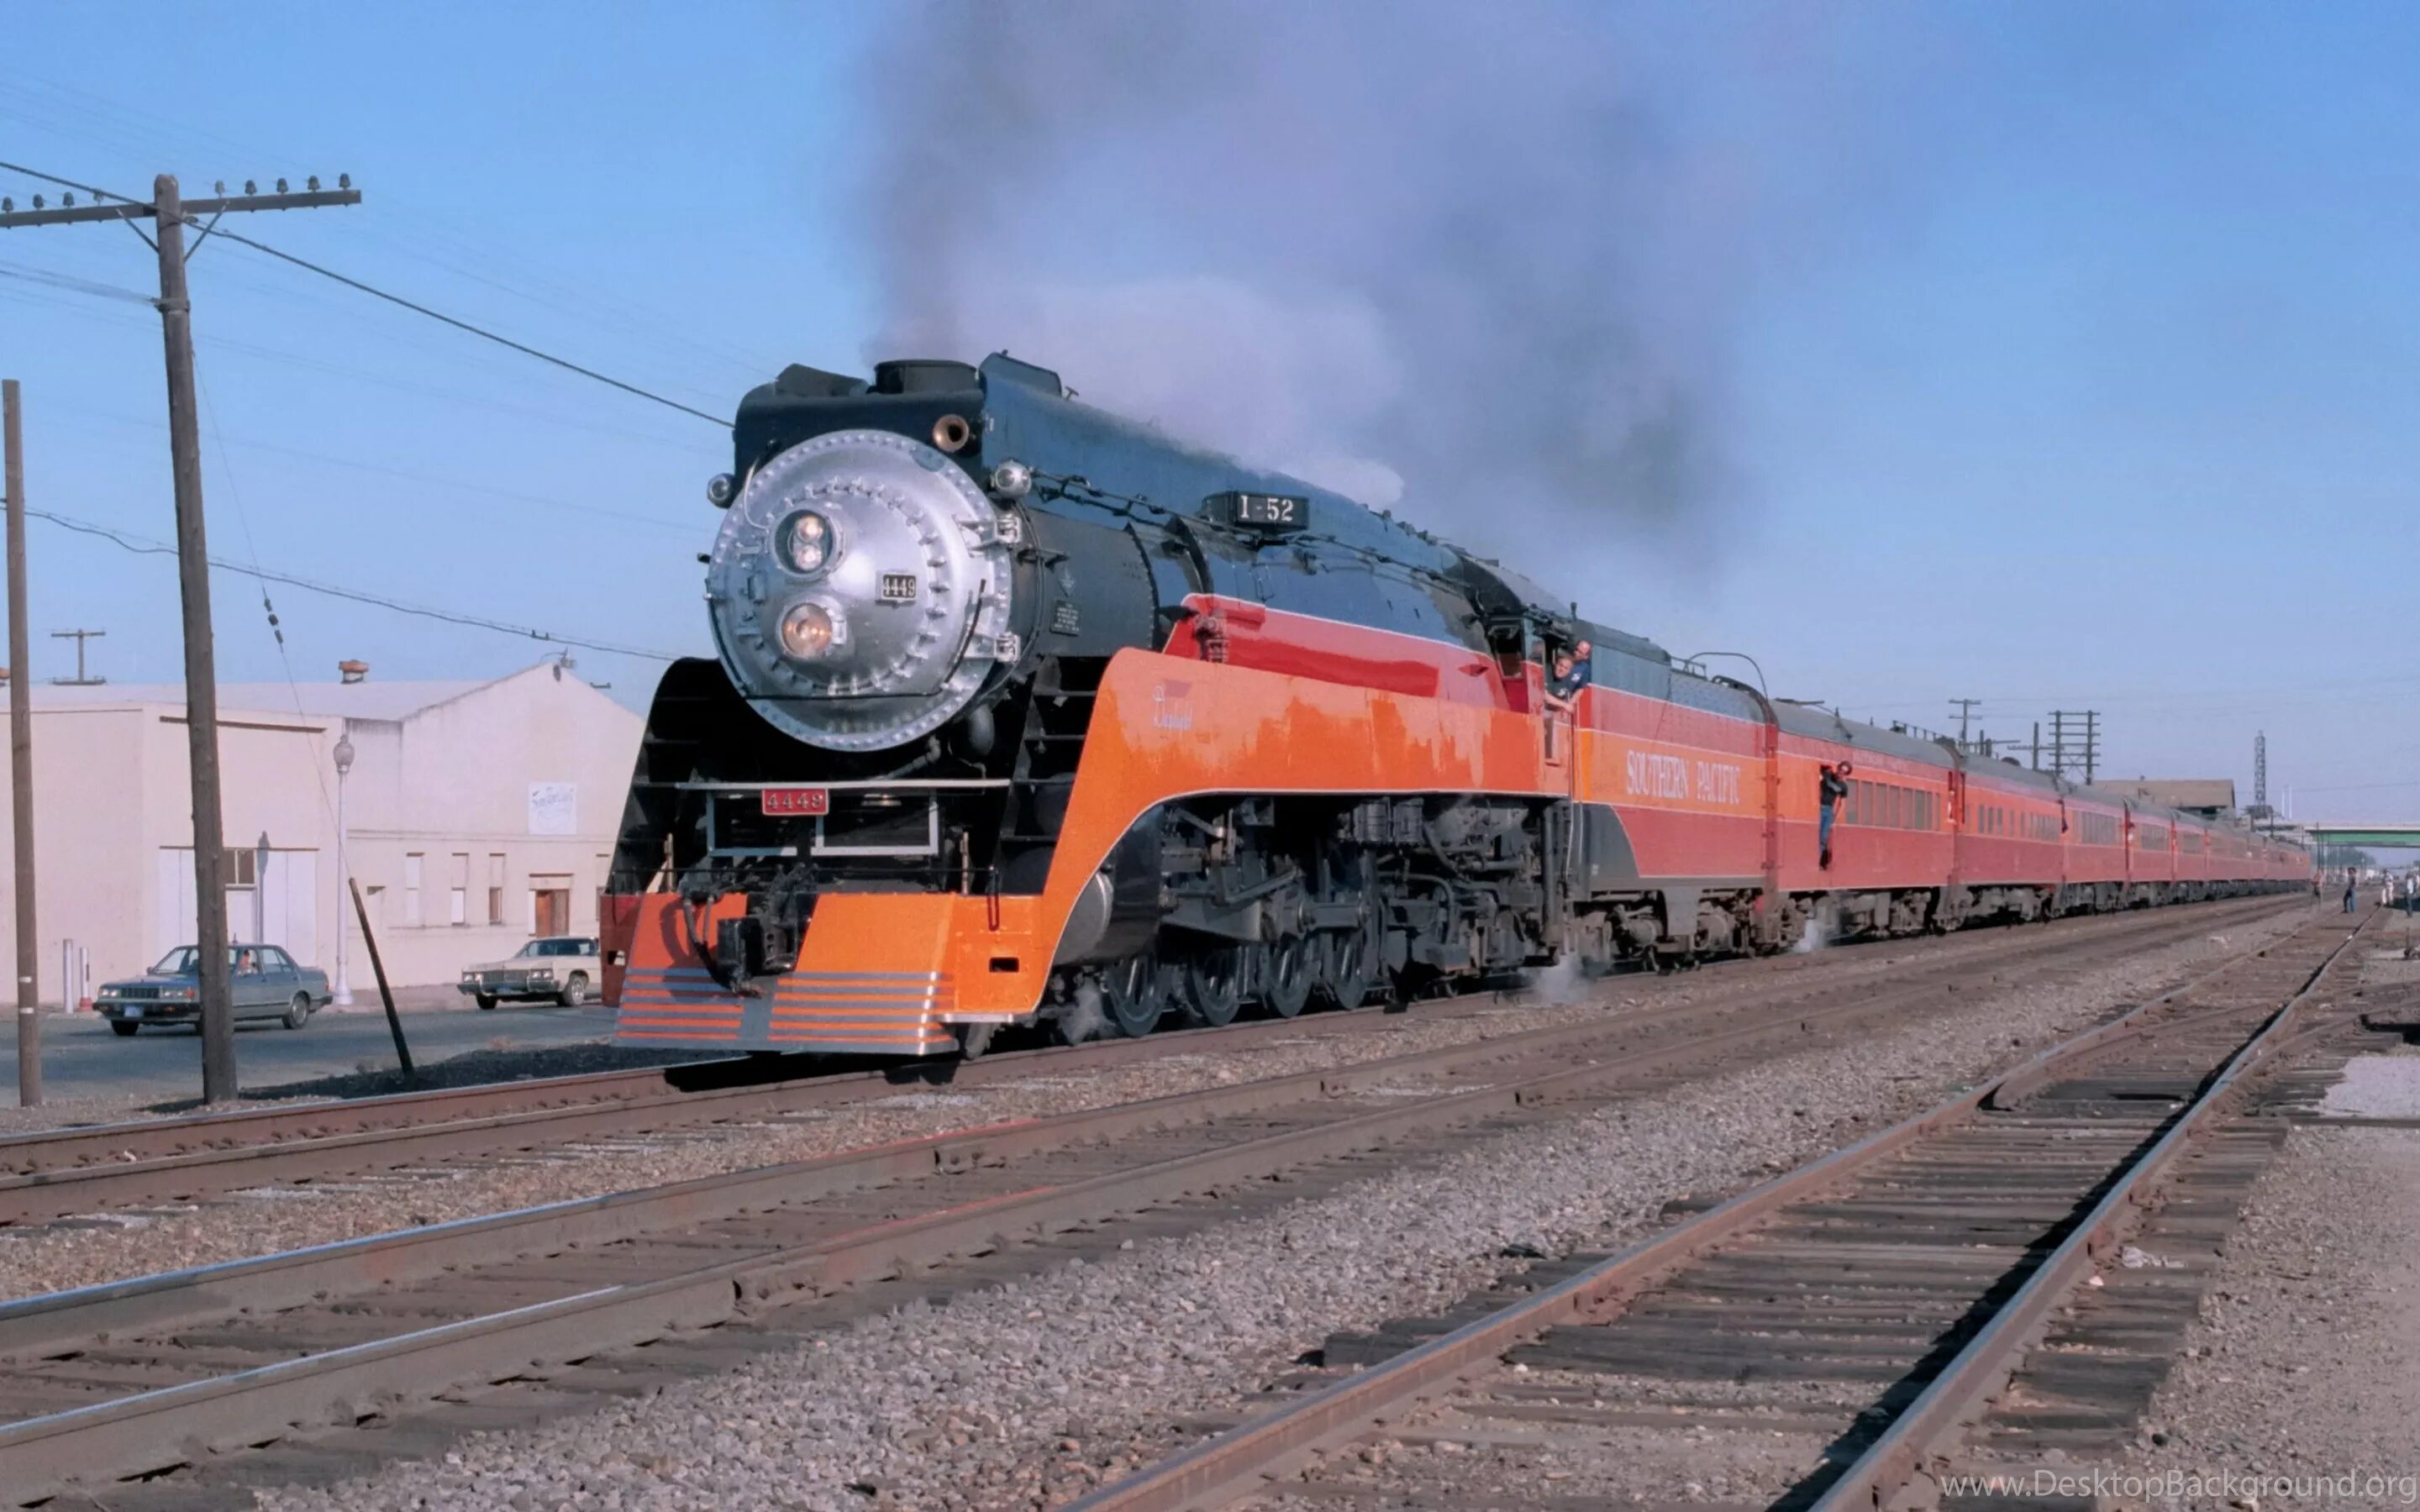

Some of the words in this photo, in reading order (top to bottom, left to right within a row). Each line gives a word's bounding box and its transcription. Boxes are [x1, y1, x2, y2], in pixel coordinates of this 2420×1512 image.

[883, 577, 915, 596] 4449
[1627, 750, 1689, 799] SOUTHERN
[1697, 761, 1740, 805] PACIFIC
[767, 792, 823, 809] 4449
